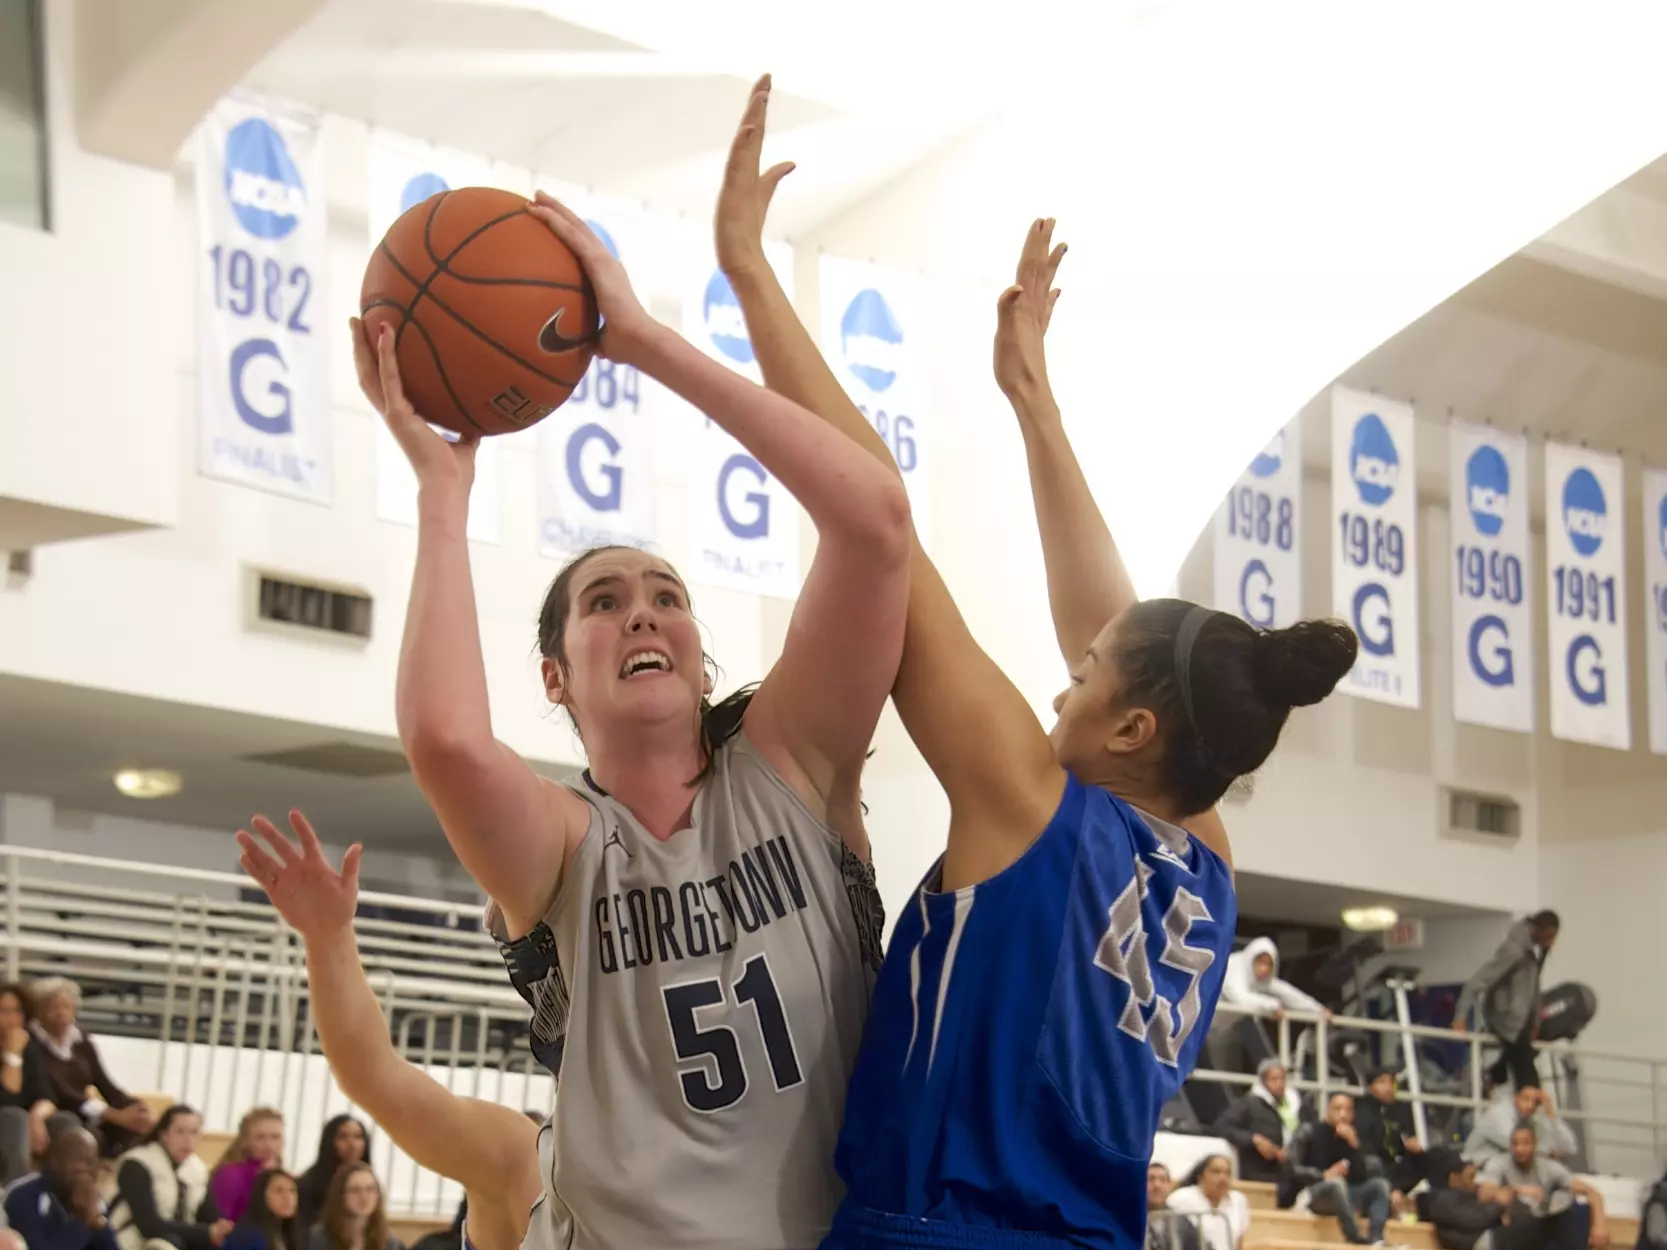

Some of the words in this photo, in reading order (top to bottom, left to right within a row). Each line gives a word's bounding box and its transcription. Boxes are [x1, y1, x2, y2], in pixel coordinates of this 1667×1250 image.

[209, 243, 312, 335] 1982
[230, 337, 294, 435] G
[565, 423, 623, 513] G
[717, 453, 771, 541] G
[1227, 485, 1294, 552] 1988
[1340, 513, 1405, 576] 1989
[1238, 559, 1275, 628] G
[1456, 545, 1524, 606] 1990
[1553, 565, 1616, 626] 1991
[1352, 582, 1395, 657] G
[1467, 614, 1515, 688] G
[1565, 634, 1608, 707] G
[594, 835, 808, 975] GEORGETOWN
[1092, 853, 1215, 1066] 45
[659, 952, 806, 1115] 51
